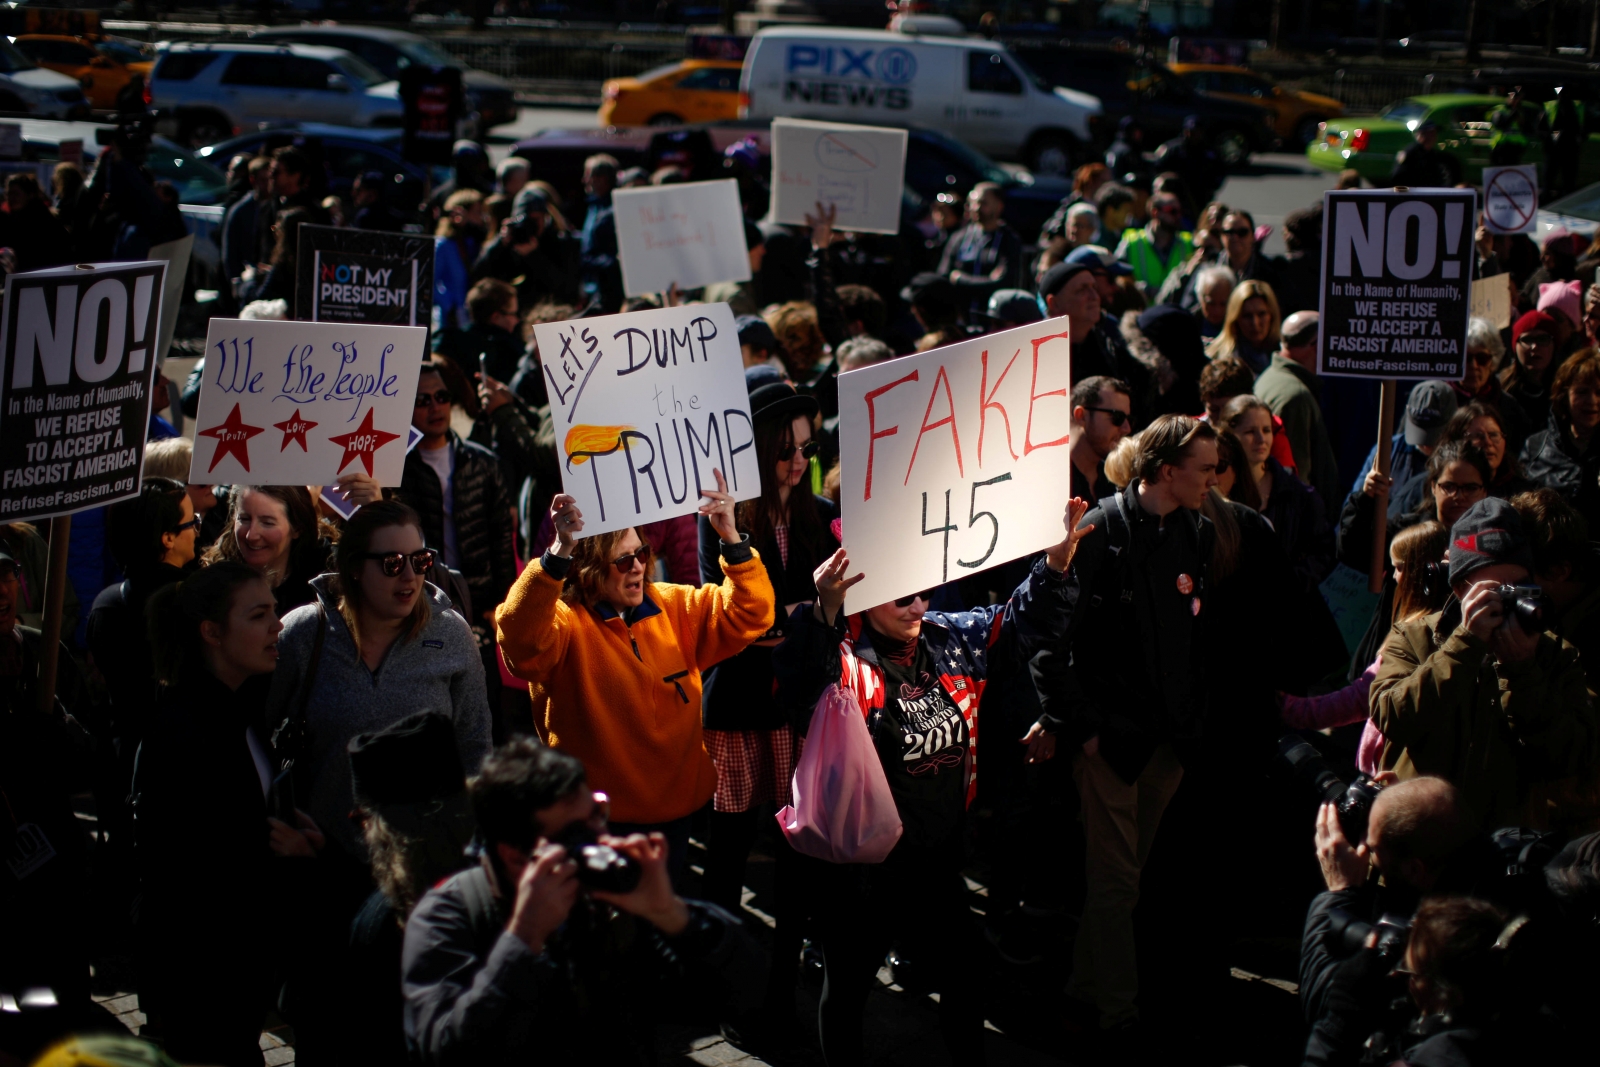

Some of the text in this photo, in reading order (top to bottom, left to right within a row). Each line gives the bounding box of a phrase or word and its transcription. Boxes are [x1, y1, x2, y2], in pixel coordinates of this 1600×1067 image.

[784, 44, 874, 78] PIX
[783, 80, 913, 111] NEWS
[1333, 200, 1465, 280] NO!
[320, 263, 392, 287] NOT MY
[1331, 281, 1462, 301] In the Name of Humanity,
[320, 283, 408, 308] PRESIDENT
[1354, 300, 1437, 318] WE REFUSE
[11, 274, 155, 390] NO!
[1348, 318, 1442, 336] TO ACCEPT A
[613, 316, 718, 376] DUMP
[1329, 335, 1459, 354] FASCIST AMERICA
[214, 337, 399, 423] We the People
[1328, 357, 1457, 374] RefuseFascism.org
[8, 381, 144, 416] In the Name of Humanity,
[652, 383, 702, 417] the
[35, 406, 122, 438] WE REFUSE
[285, 421, 307, 434] LOVE
[863, 330, 1070, 502] FAKE
[26, 428, 124, 463] TO ACCEPT A
[215, 427, 248, 442] TRUTH
[348, 433, 378, 452] HOPE
[3, 447, 137, 490] FASCIST AMERICA
[566, 408, 754, 523] TRUMP
[0, 477, 134, 514] RefuseFascism.org
[921, 471, 1013, 583] 45
[902, 713, 963, 762] 2017
